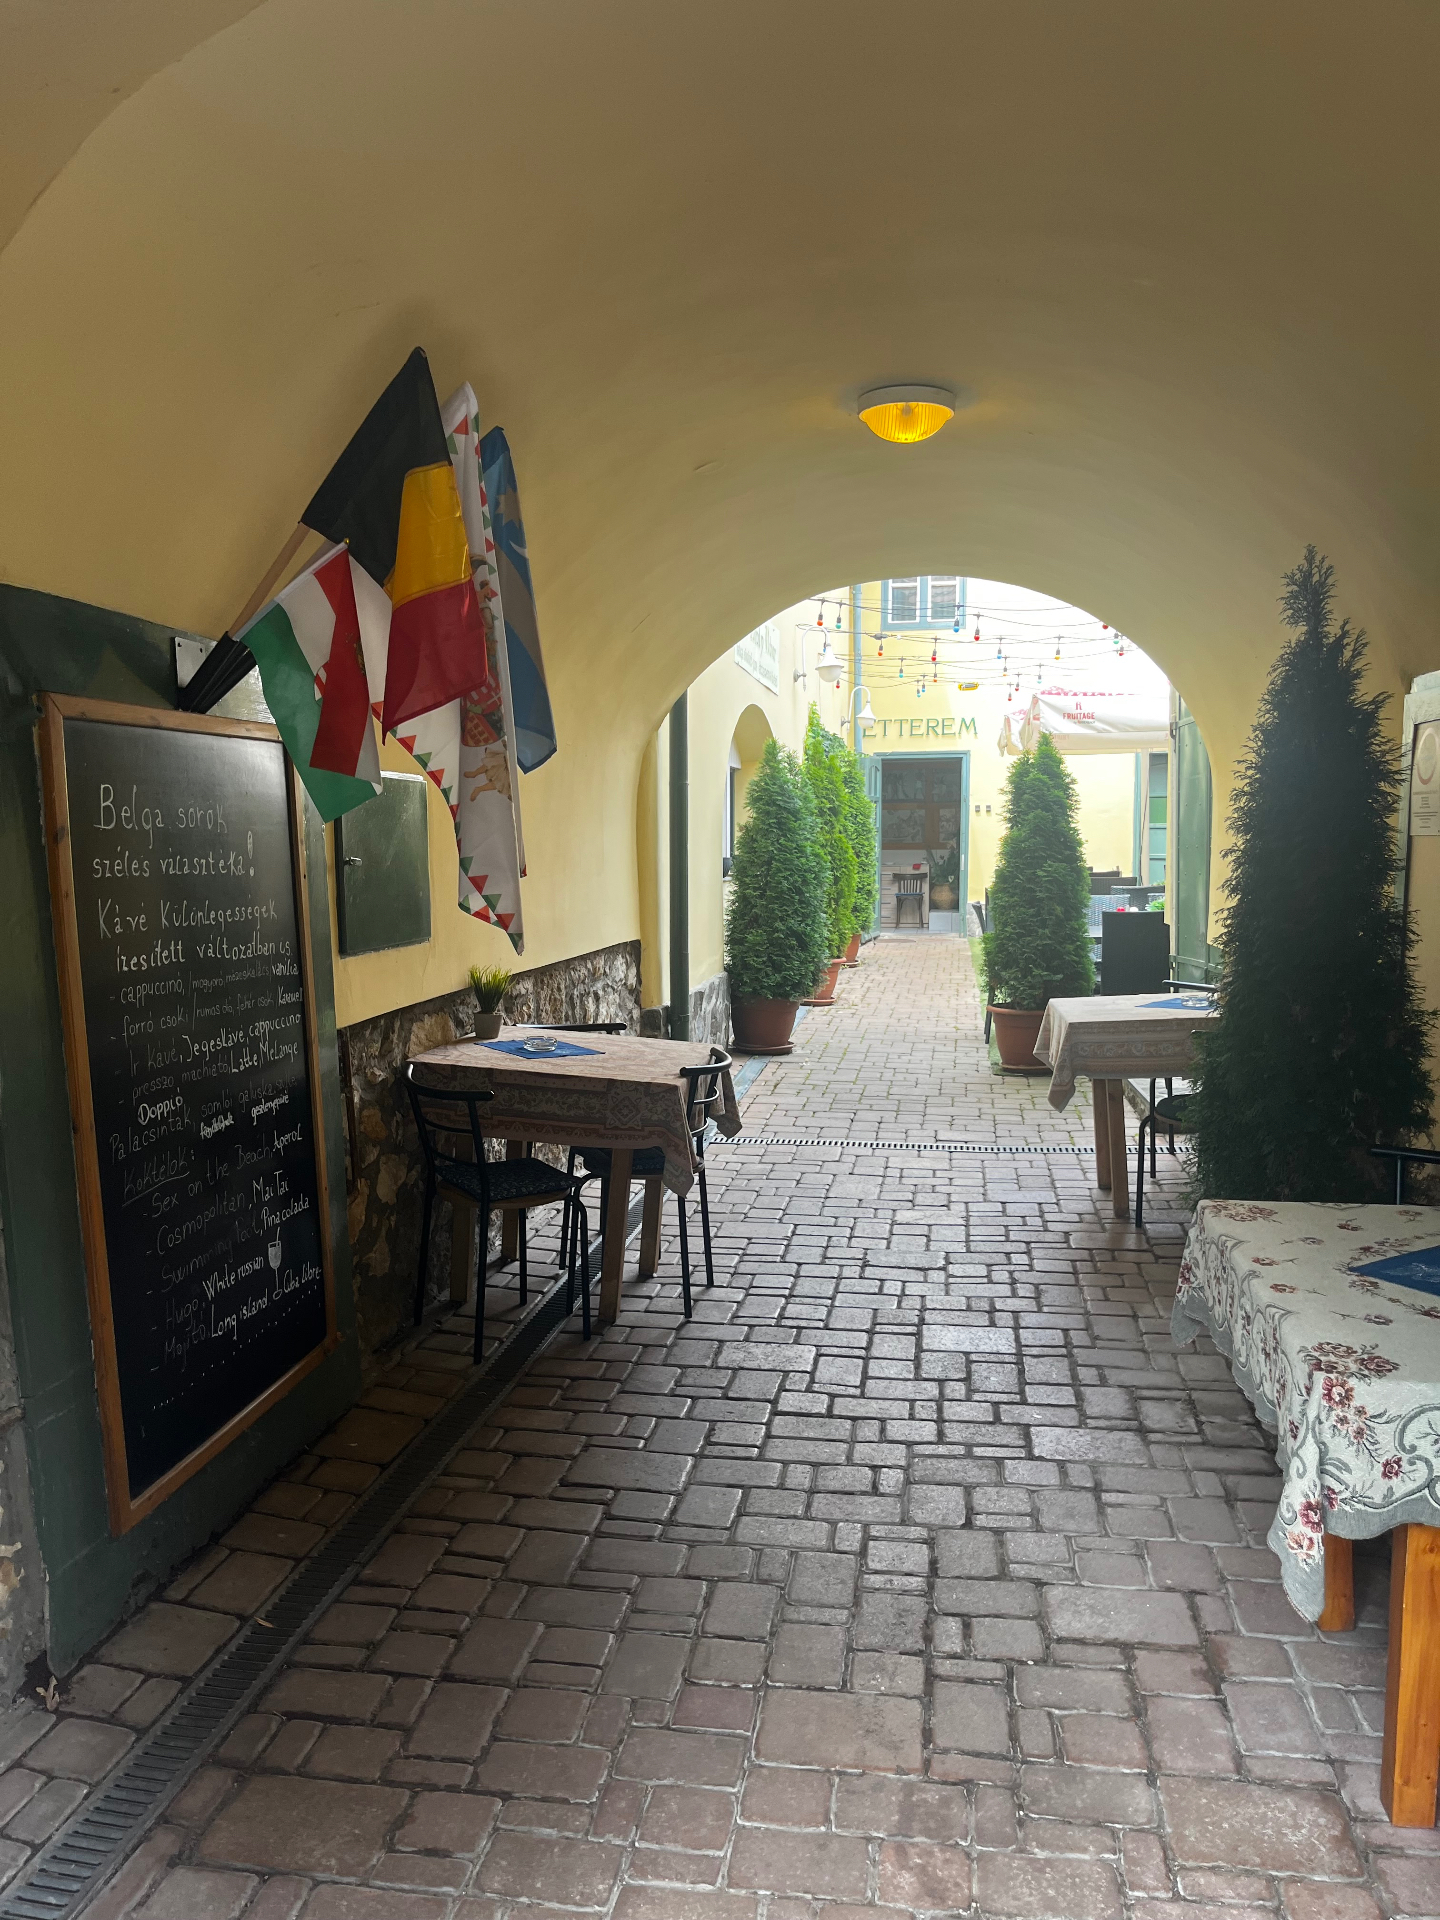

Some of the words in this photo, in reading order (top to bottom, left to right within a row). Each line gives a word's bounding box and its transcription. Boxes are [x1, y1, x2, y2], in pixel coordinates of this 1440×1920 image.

[1062, 712, 1096, 720] FRUITAGE
[94, 783, 165, 850] Belga
[92, 845, 151, 879] széles
[196, 931, 276, 961] változatban
[121, 1010, 154, 1048] forró
[248, 1012, 303, 1042] cappuccino
[151, 1191, 180, 1219] Sex
[187, 1179, 204, 1197] on
[206, 1155, 230, 1186] the
[272, 1122, 304, 1157] Aperol
[252, 1175, 275, 1204] Mai
[273, 1169, 290, 1197] Tai
[161, 1238, 234, 1294] Swimming
[202, 1262, 237, 1302] White
[237, 1255, 265, 1282] russian
[210, 1304, 238, 1341] Long
[282, 1268, 301, 1294] Cuba
